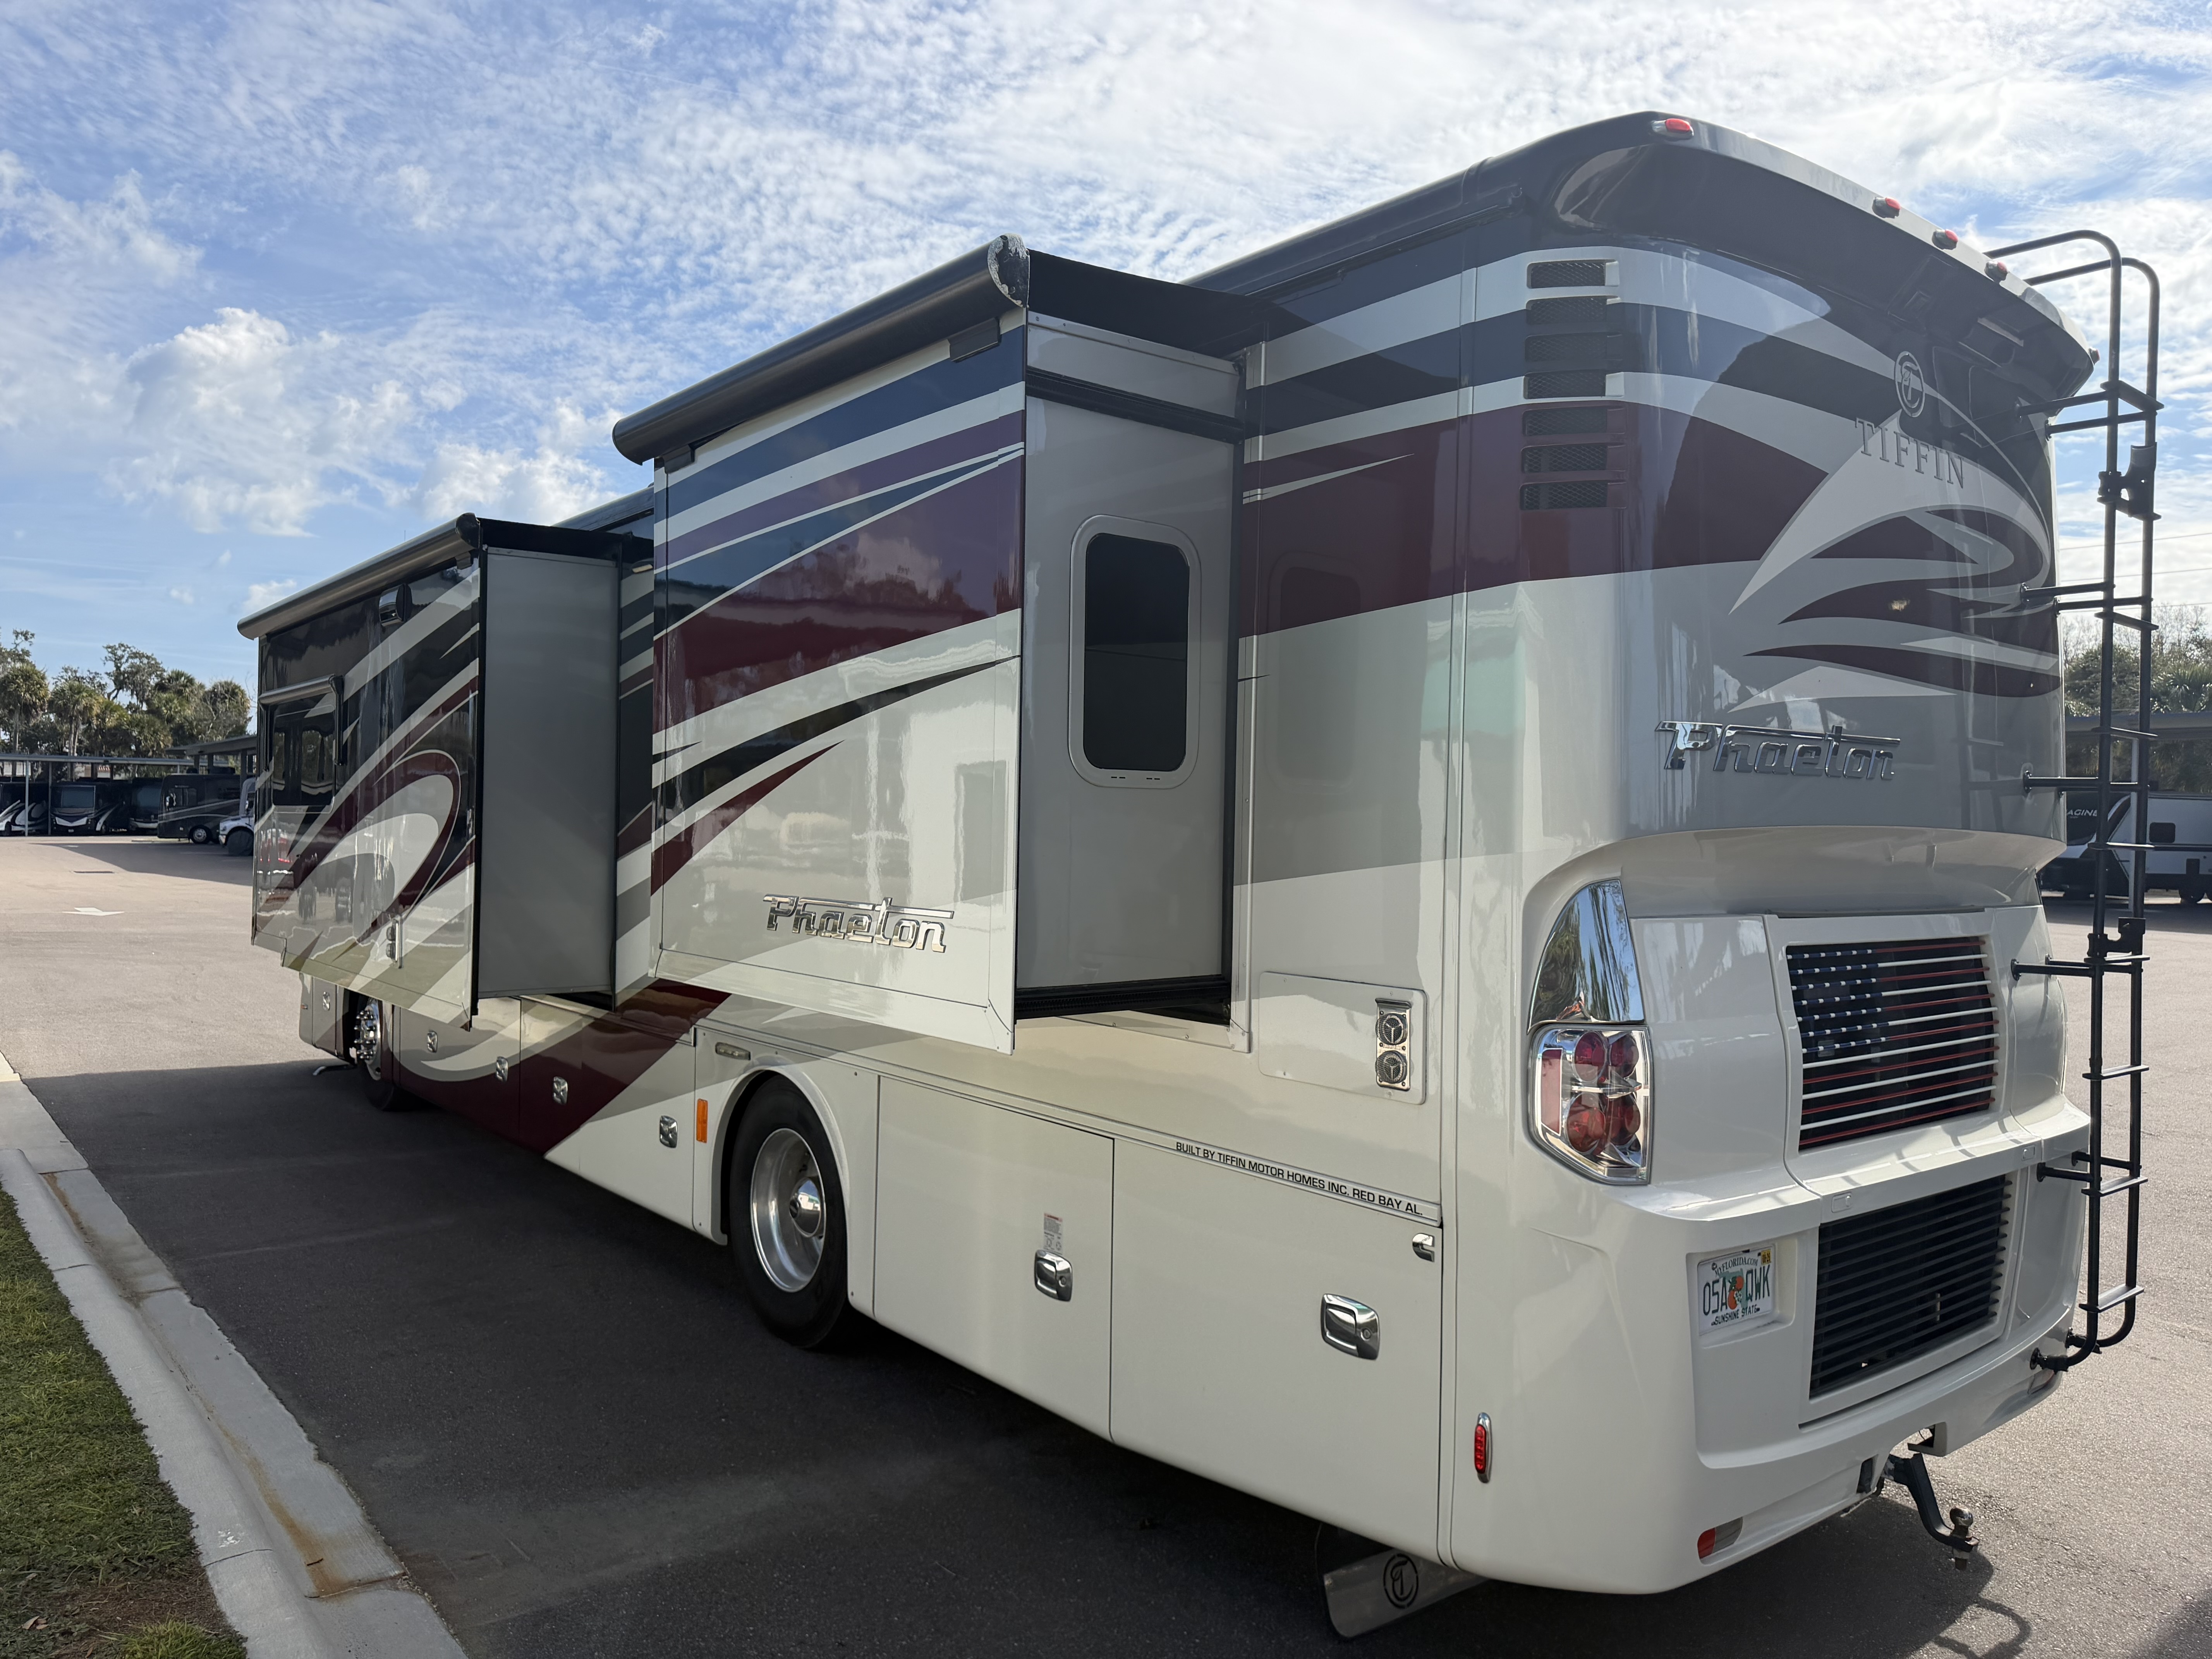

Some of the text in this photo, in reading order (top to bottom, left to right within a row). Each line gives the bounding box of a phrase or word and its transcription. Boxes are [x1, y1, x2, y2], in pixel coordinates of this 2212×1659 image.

[1855, 417, 1965, 489] TIFFIN
[1654, 719, 1901, 781] Phaeton
[763, 893, 955, 954] Phaeton
[1176, 1141, 1423, 1216] BUILT BY TIFFIN MOTOR HOMES INC. RED BAY AL.
[1745, 1264, 1770, 1302] QWK
[1714, 1304, 1757, 1326] SUNSHINE STATE
